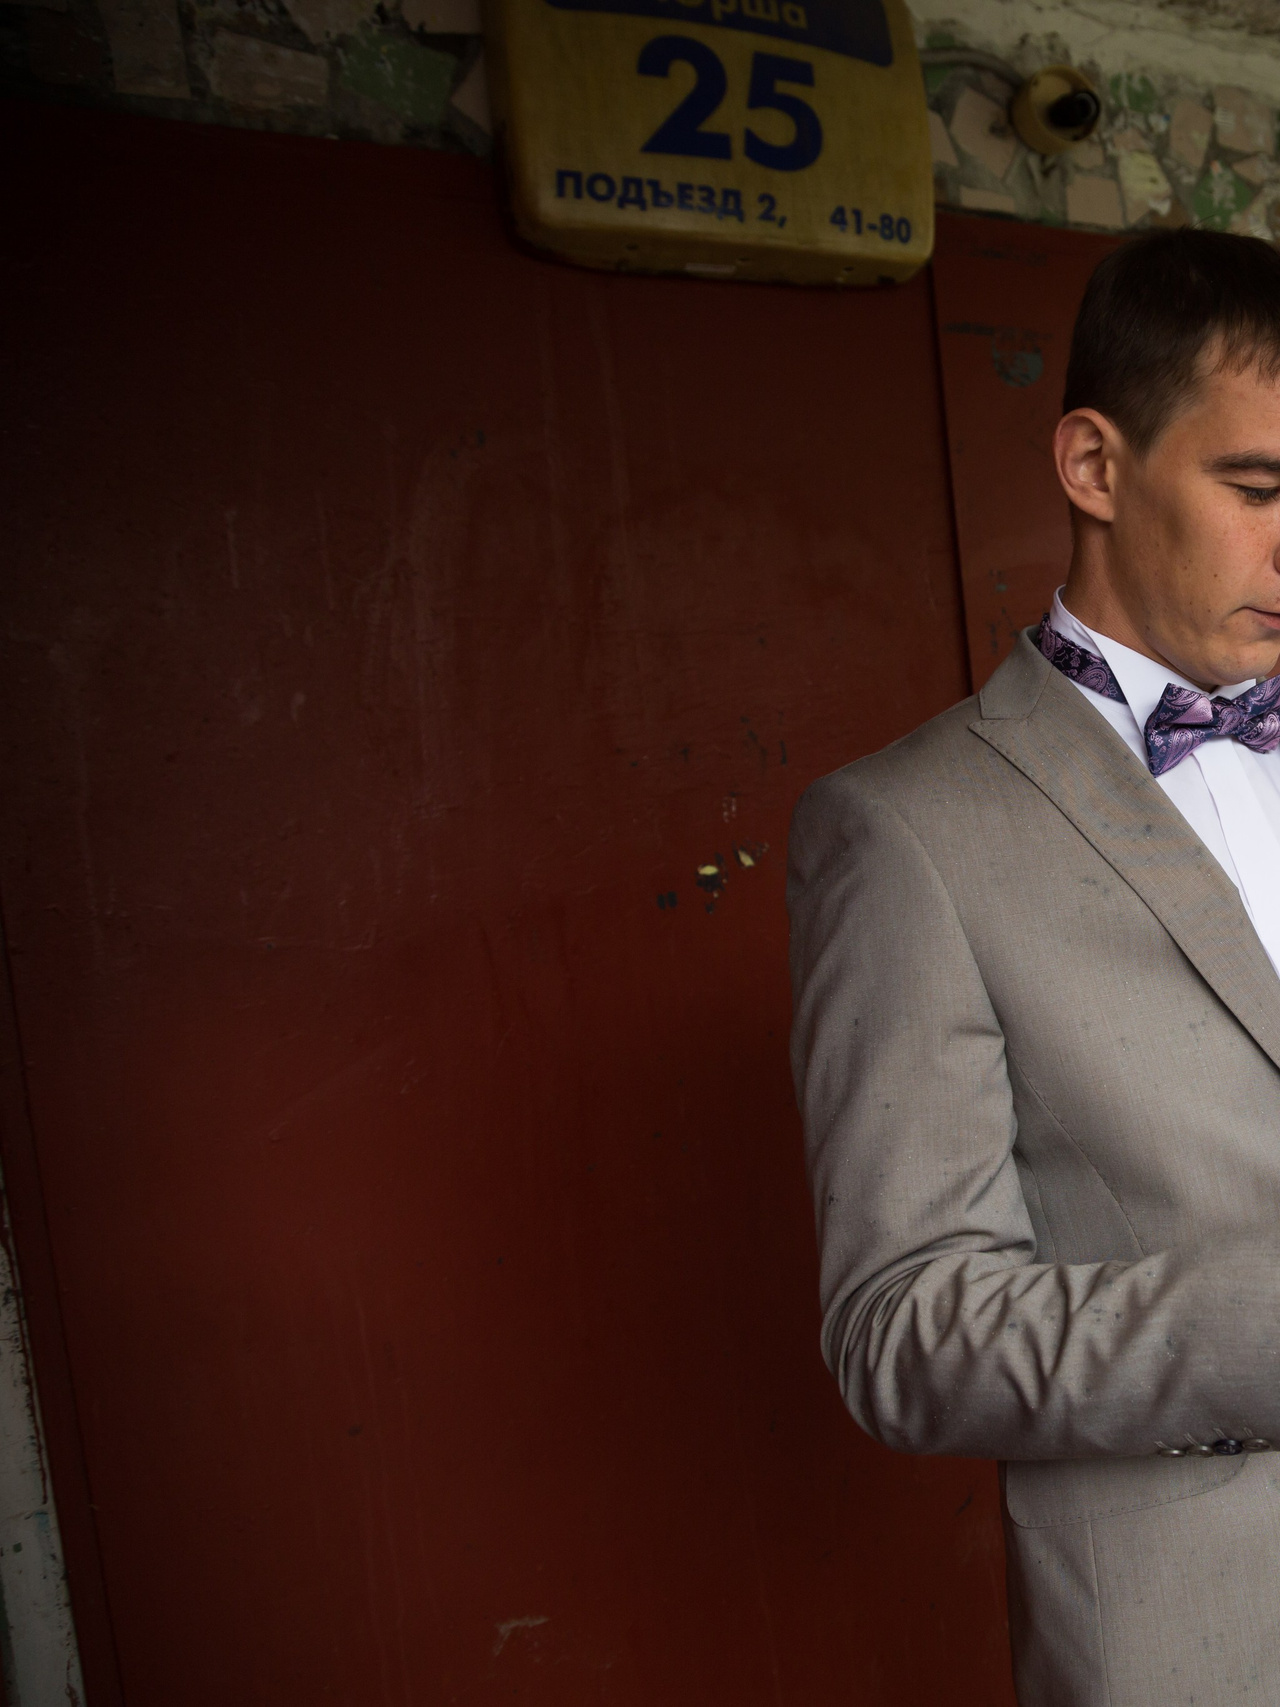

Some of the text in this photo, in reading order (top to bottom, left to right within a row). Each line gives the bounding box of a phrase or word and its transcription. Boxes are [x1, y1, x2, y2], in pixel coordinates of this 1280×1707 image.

[657, 0, 808, 29] рша
[637, 35, 824, 172] 25
[555, 169, 912, 245] ПОДЪЕЗД 2, 41-80
